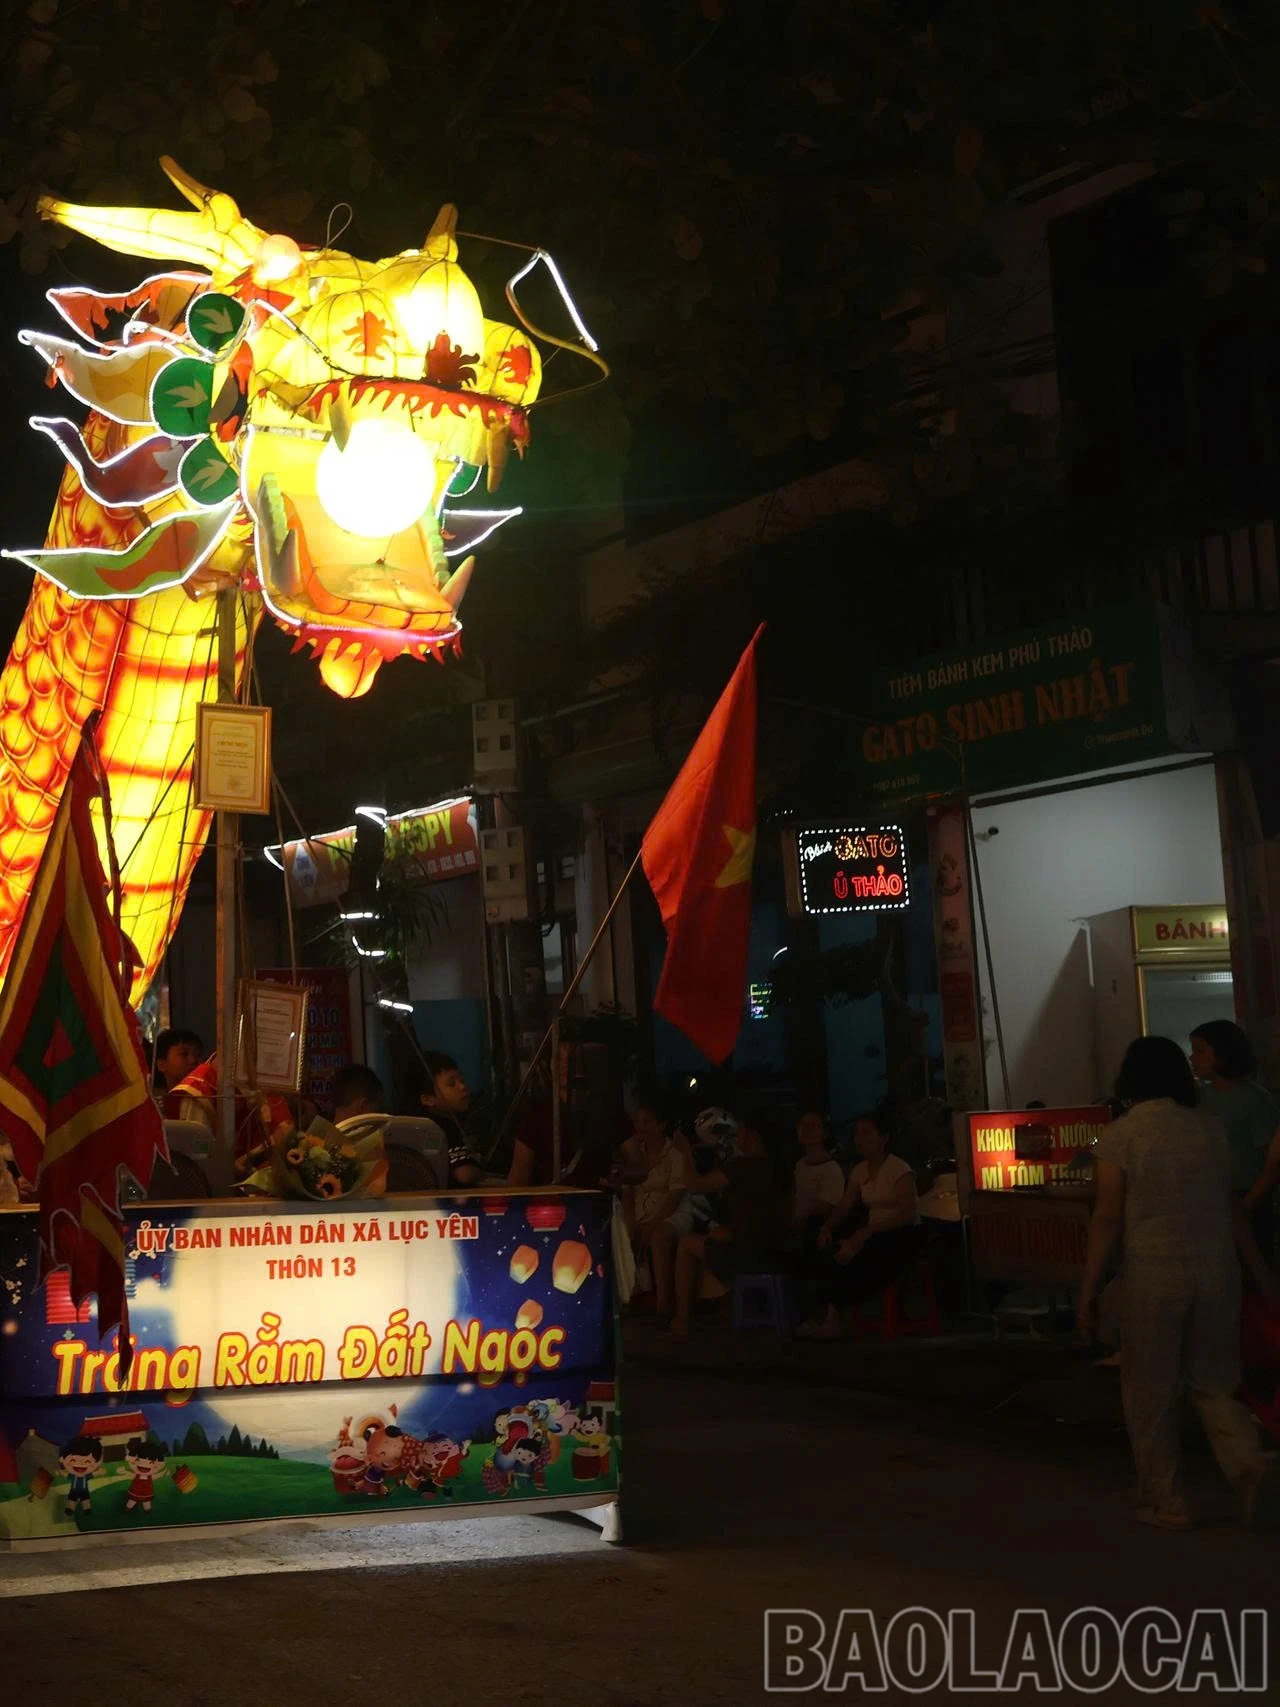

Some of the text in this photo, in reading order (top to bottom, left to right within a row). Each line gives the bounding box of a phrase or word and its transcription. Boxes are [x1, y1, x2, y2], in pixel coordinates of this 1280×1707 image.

[927, 660, 969, 690] BÁNH
[861, 711, 938, 764] GATO
[946, 688, 1025, 742] SINH
[1034, 657, 1137, 730] NHẬT
[851, 864, 903, 898] THẢO
[1155, 916, 1226, 941] BÁNH
[981, 1162, 1004, 1190] MÌ
[1008, 1160, 1045, 1187] TÔM
[136, 1213, 478, 1252] ỦY BAN NHÂN DÂN XÃ LỤC YÊN
[266, 1254, 357, 1280] THÔN 13
[213, 1310, 325, 1390] Rằm
[338, 1308, 432, 1381] Đất
[442, 1317, 566, 1389] Ngọc
